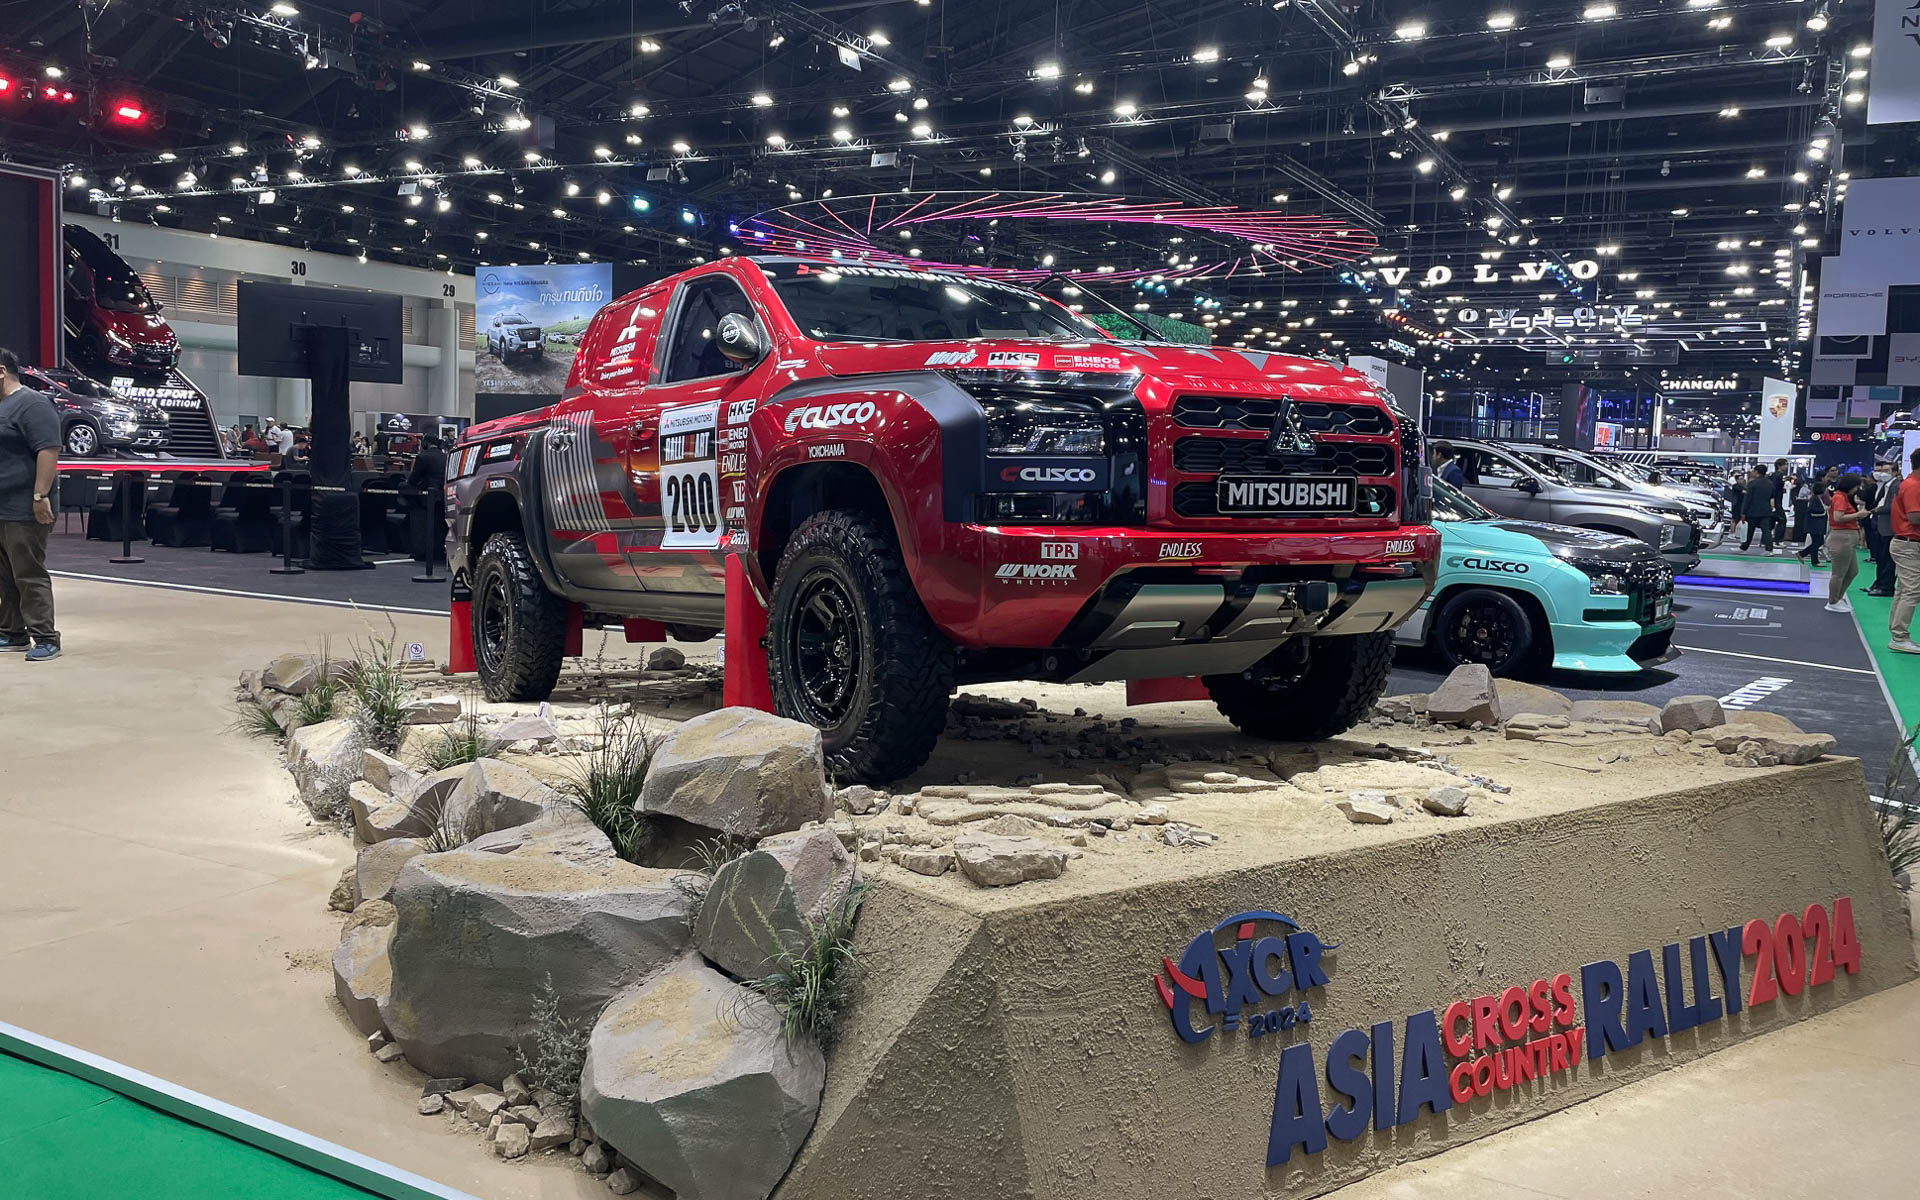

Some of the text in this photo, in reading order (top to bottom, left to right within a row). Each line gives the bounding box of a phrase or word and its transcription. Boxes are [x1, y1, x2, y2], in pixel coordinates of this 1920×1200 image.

[1849, 228, 1920, 236] VOLV
[103, 234, 120, 250] 31
[291, 261, 306, 276] 30
[1379, 260, 1599, 286] VOLVO
[824, 265, 1042, 300] MITSUBISHI MOTORS
[442, 284, 456, 297] 29
[1489, 314, 1643, 328] PORSCHE
[1388, 338, 1416, 357] PORSCHE
[989, 353, 1039, 364] HKS
[1074, 356, 1121, 365] ENEOS
[112, 377, 134, 387] NEW
[1660, 380, 1738, 390] CHANGAN
[156, 388, 196, 400] SPORT
[729, 402, 754, 417] HKS
[800, 402, 875, 429] CUSCO
[1821, 432, 1852, 441] YAMAHA
[808, 443, 845, 458] YOKOHAMA
[1020, 467, 1096, 482] CUSCO
[1228, 483, 1347, 506] MITSUBISHI
[667, 472, 717, 533] 200
[1043, 543, 1076, 558] TPR
[1159, 542, 1202, 558] ENDLESS
[1385, 540, 1415, 554] ENDLESS
[1021, 564, 1077, 578] WORK
[1463, 558, 1529, 574] CUSCO
[1158, 925, 1335, 1043] AXCR
[1581, 897, 1862, 1060] RALLY 2024
[1250, 1001, 1313, 1039] 2024
[1443, 974, 1571, 1057] CROSS
[1449, 1028, 1584, 1104] COUNTRY
[1267, 1009, 1453, 1167] ASIA
